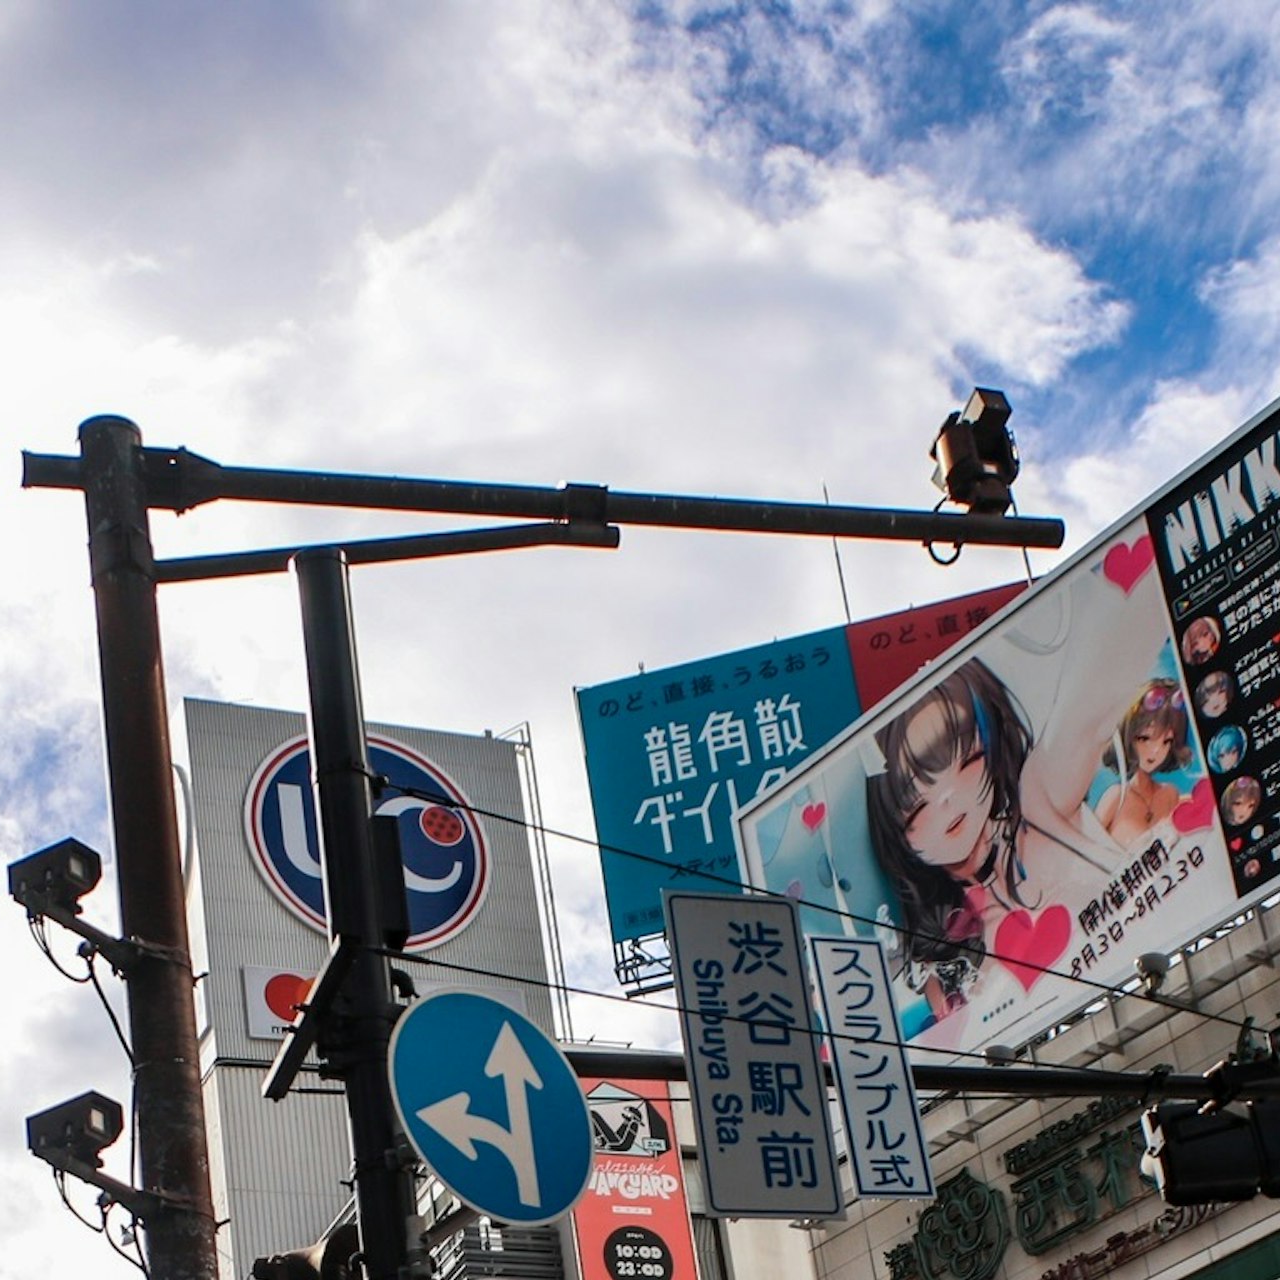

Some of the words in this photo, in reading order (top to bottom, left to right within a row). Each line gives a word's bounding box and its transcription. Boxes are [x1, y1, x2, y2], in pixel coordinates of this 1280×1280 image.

[643, 693, 809, 788] 龍角散
[1078, 838, 1170, 937] 開催期間
[692, 957, 734, 1081] Shibuya
[725, 920, 818, 1192] 渋谷駅前
[832, 946, 917, 1192] スクランブル式
[709, 1092, 746, 1156] Sta.
[615, 1244, 663, 1260] 10:00
[616, 1261, 665, 1278] 23:00
